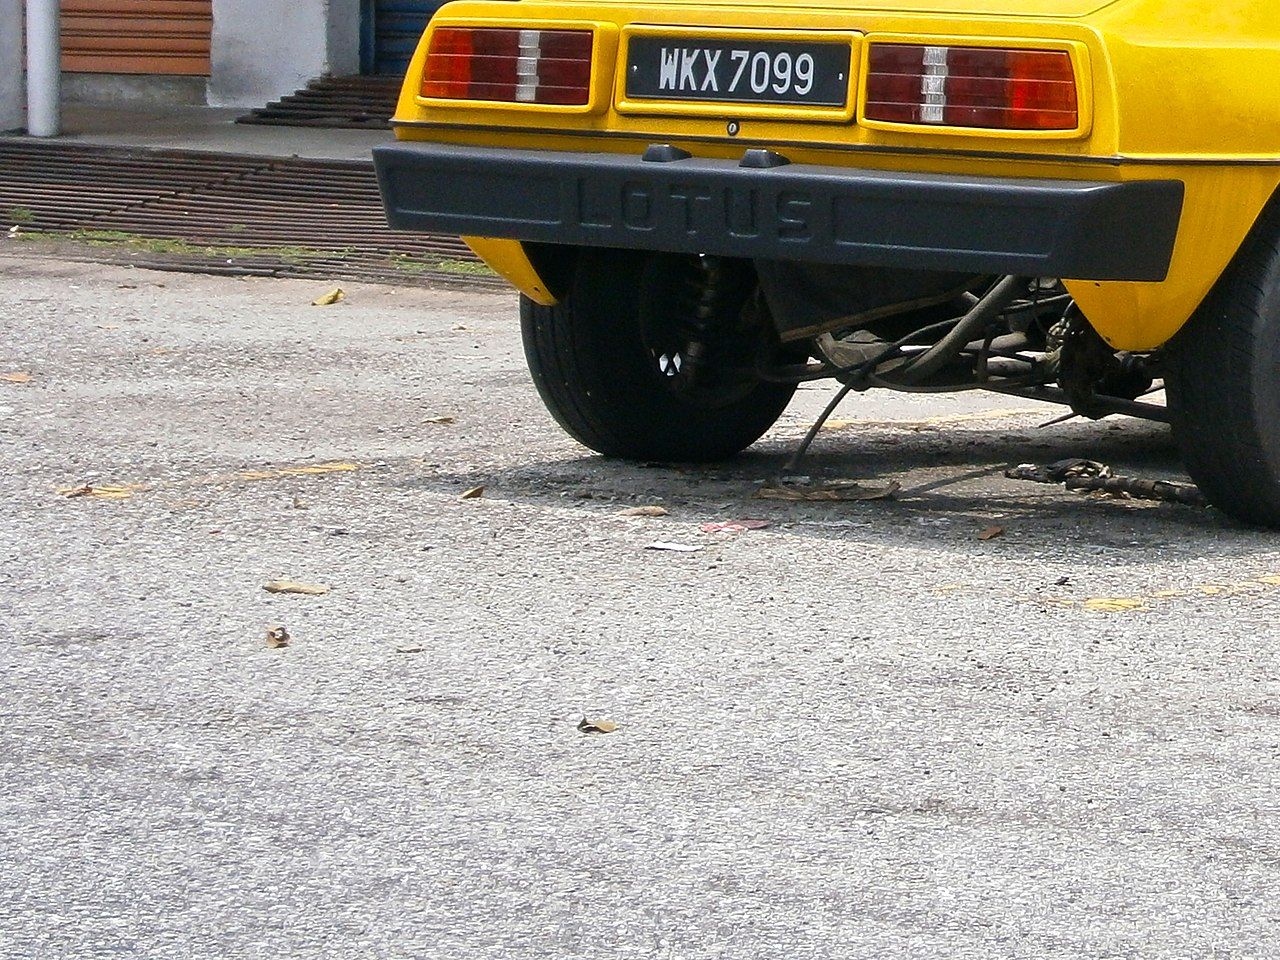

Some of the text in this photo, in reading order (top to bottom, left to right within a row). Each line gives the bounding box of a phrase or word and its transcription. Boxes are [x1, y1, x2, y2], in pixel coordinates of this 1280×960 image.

[659, 48, 814, 95] WKX 7099
[577, 177, 815, 242] LOTUS
